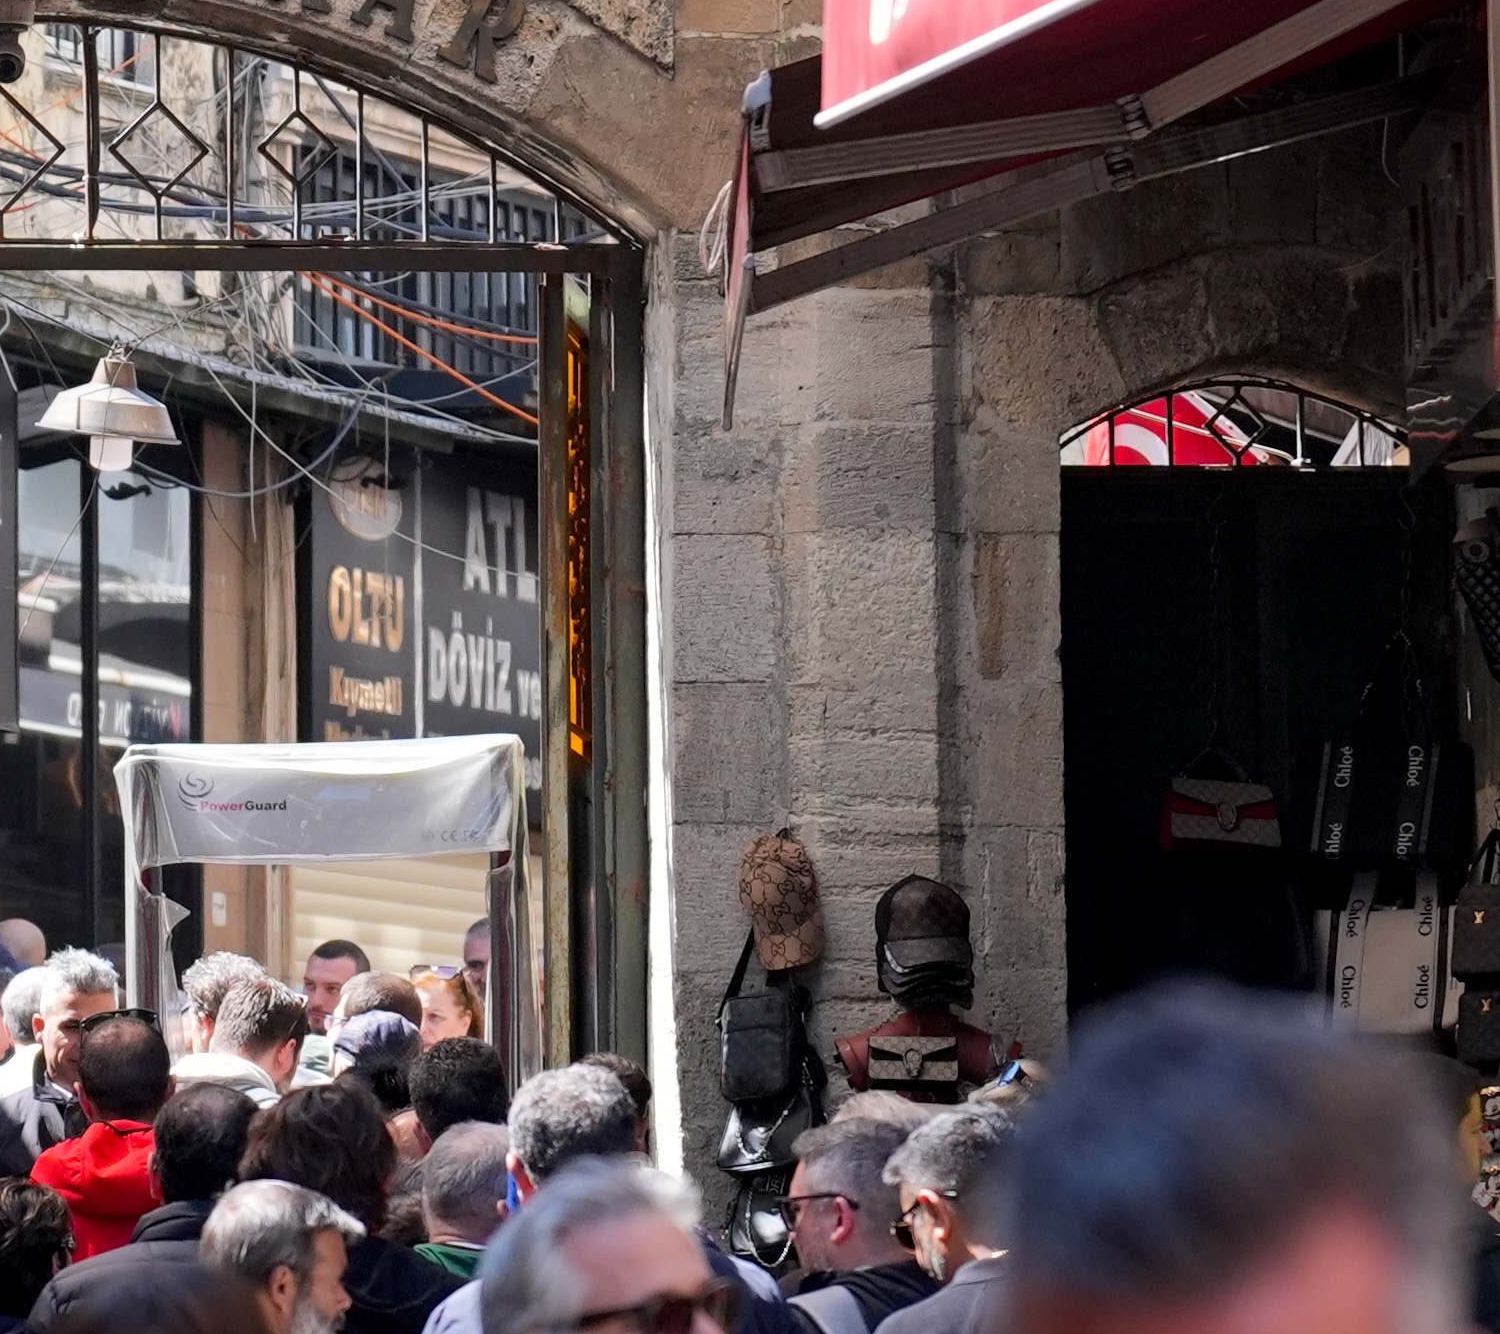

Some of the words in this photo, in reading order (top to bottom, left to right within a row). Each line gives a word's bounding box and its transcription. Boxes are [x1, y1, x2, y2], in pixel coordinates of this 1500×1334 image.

[328, 565, 404, 653] OLTU
[427, 609, 513, 715] DÖVİZ
[1334, 745, 1354, 788] Chloé
[1405, 745, 1425, 788] Chloé
[200, 799, 287, 812] PowerGuard
[1346, 899, 1365, 938] Chloé
[1418, 896, 1434, 937] Chloé
[1340, 965, 1356, 1009] Chloé
[1414, 965, 1430, 1009] Chloé
